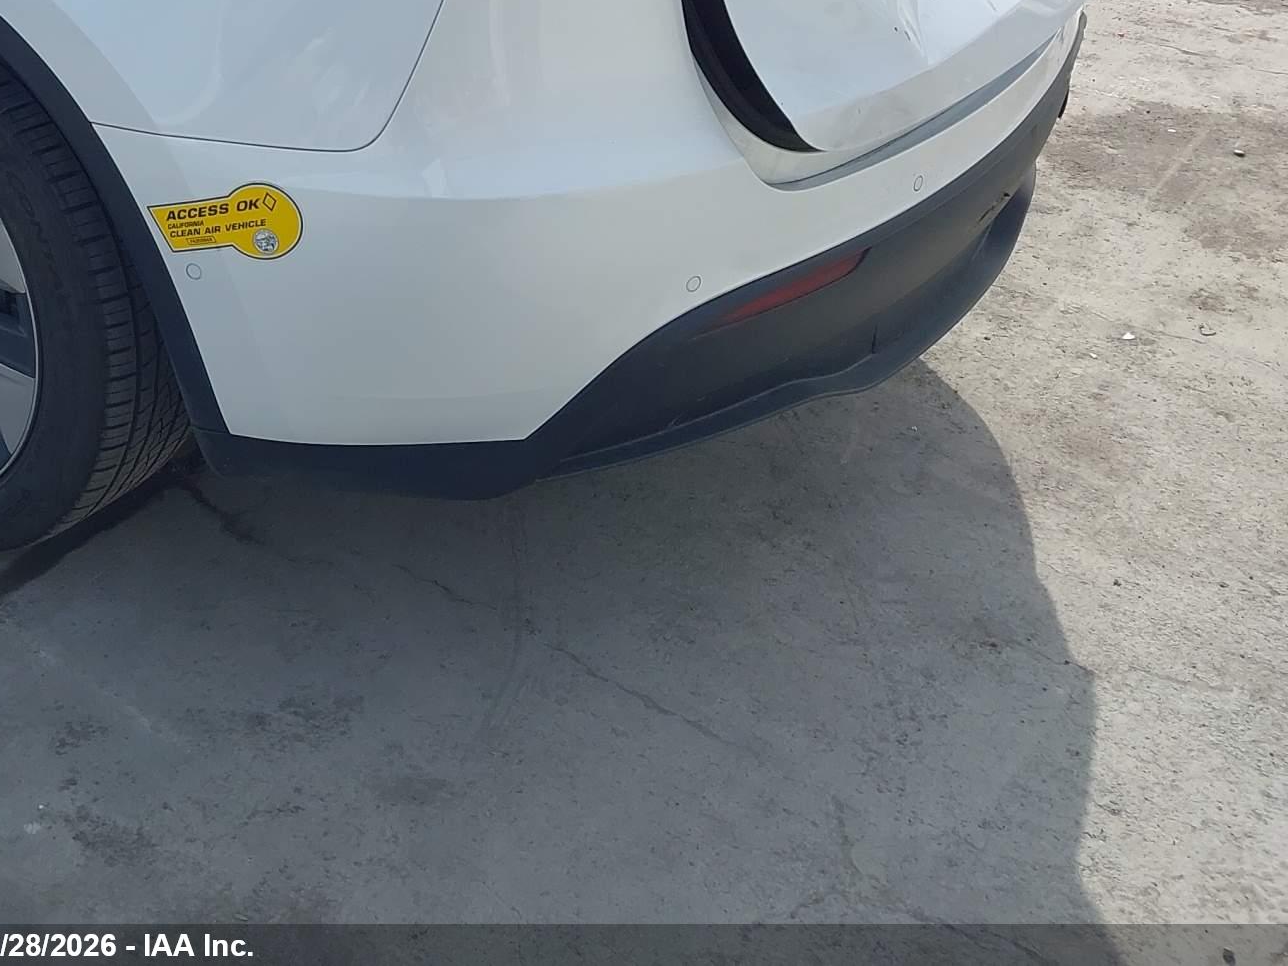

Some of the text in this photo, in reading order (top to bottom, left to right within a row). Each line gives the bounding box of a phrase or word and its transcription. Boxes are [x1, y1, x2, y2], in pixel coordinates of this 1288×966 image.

[166, 198, 261, 221] ACCESS OK
[168, 220, 204, 230] CALIFORNIA
[170, 218, 267, 238] CLEAN AIR VEHICLE
